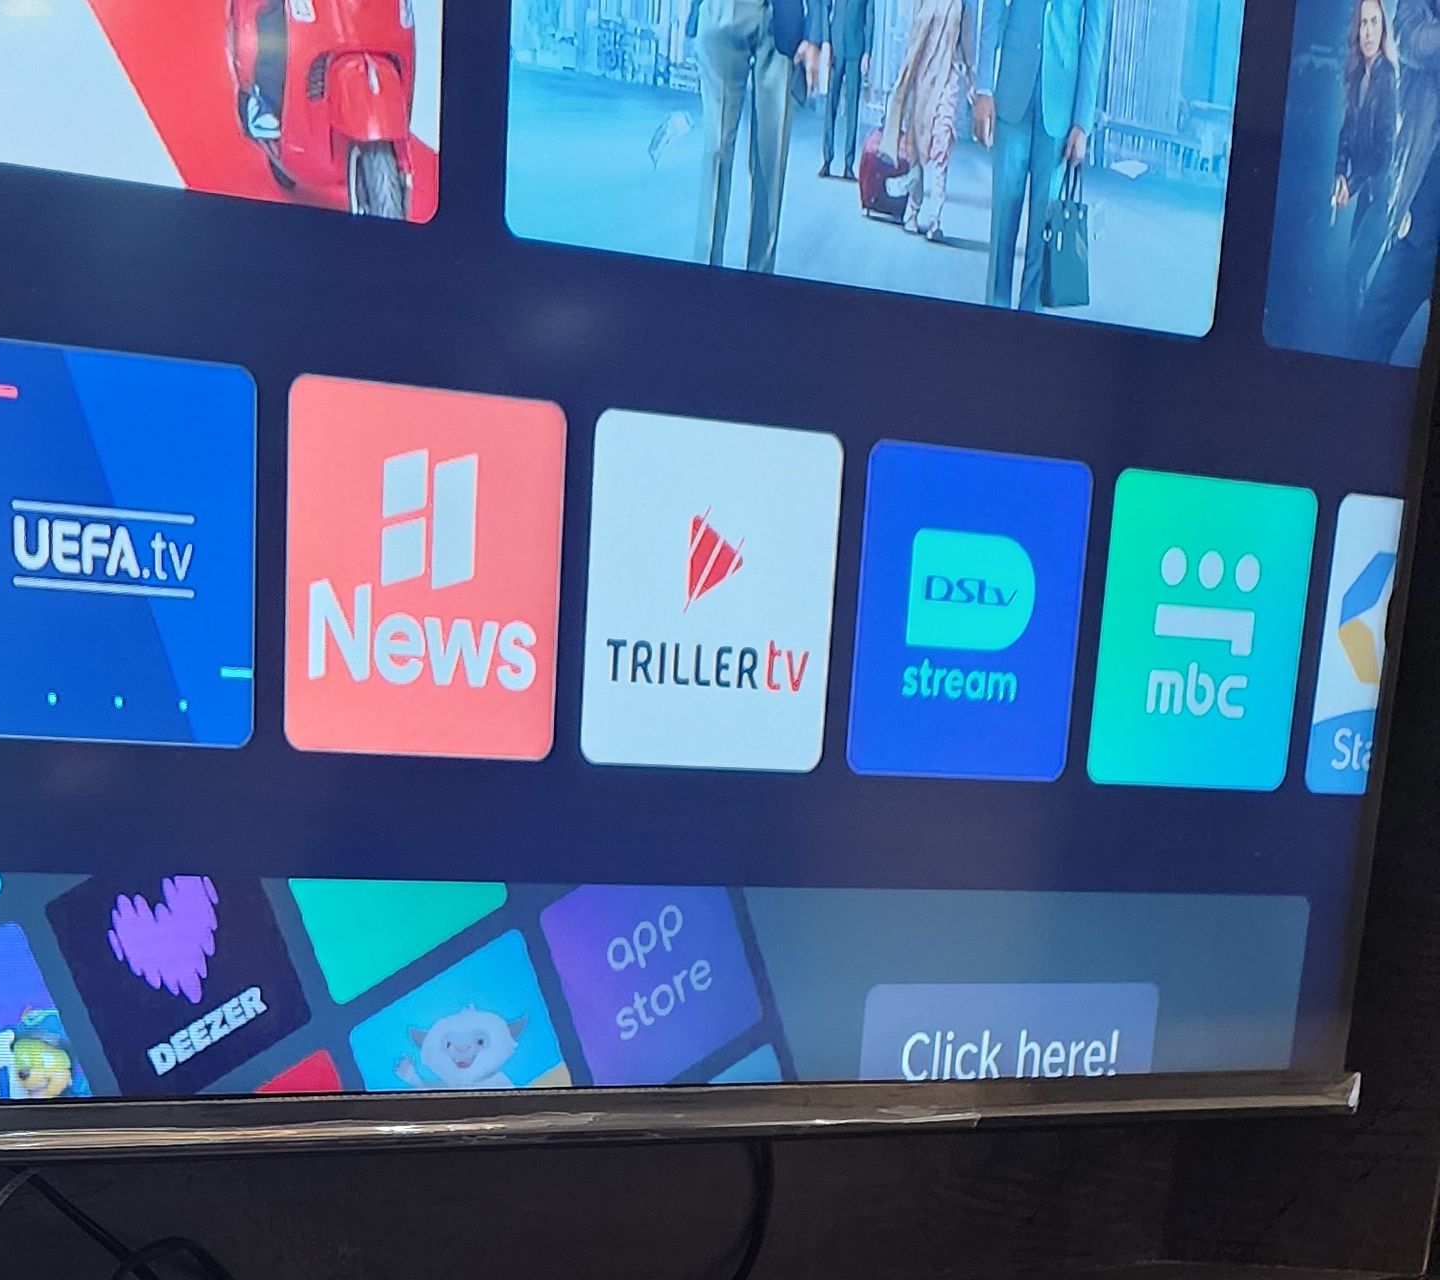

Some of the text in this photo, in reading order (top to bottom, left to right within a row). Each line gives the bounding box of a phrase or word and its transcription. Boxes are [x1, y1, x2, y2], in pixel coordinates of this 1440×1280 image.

[12, 514, 195, 581] UEFA.tv
[307, 578, 538, 691] News
[902, 658, 1018, 702] stream
[1146, 662, 1248, 719] mbc
[606, 904, 684, 971] app
[147, 986, 268, 1076] DEEZER
[614, 959, 713, 1041] store
[901, 1029, 1121, 1081] Click here!
